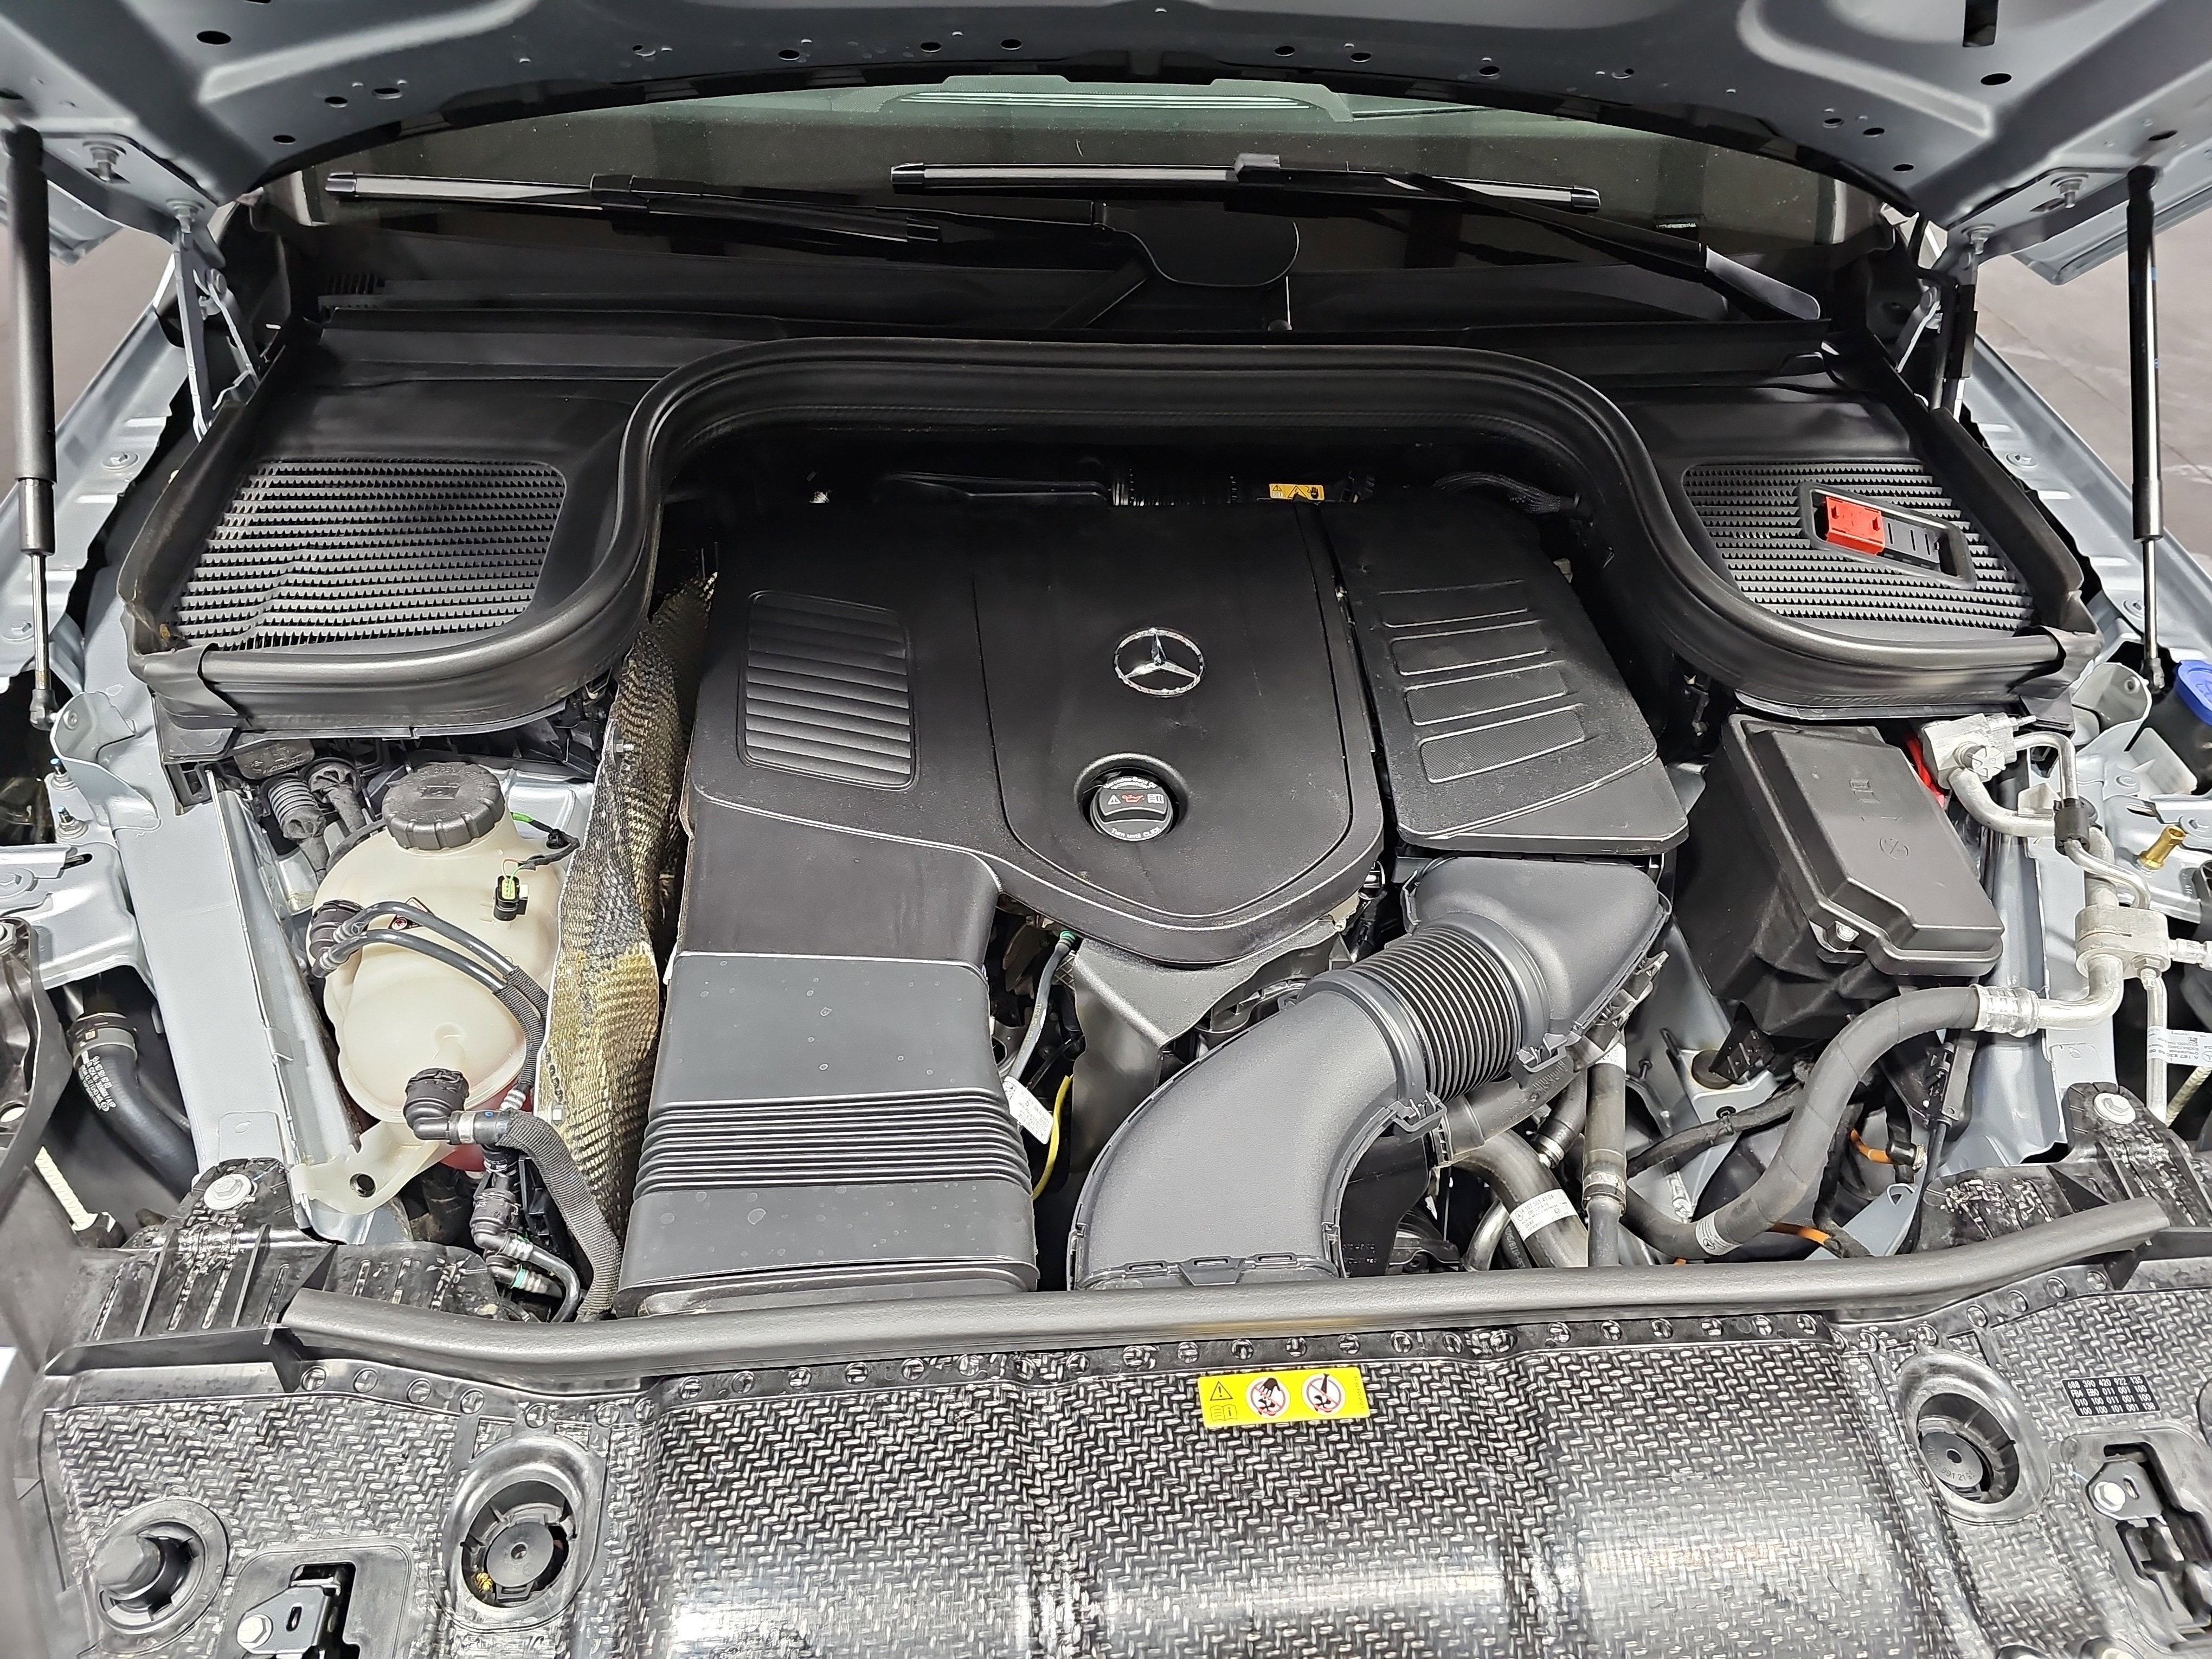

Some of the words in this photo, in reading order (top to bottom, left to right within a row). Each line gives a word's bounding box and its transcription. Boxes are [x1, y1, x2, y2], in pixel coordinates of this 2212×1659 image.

[1103, 776, 1148, 788] Mercedes-Benz
[1111, 827, 1126, 838] Turn
[1143, 827, 1162, 838] CLICK
[2067, 1381, 2080, 1389] 688
[2130, 1376, 2143, 1384] 135
[2074, 1398, 2088, 1406] 010
[2091, 1397, 2104, 1405] 100
[2106, 1396, 2119, 1404] 011
[2122, 1395, 2135, 1403] 001
[2079, 1407, 2092, 1415] 100
[2095, 1406, 2108, 1414] 100
[1941, 1468, 1955, 1479] 991
